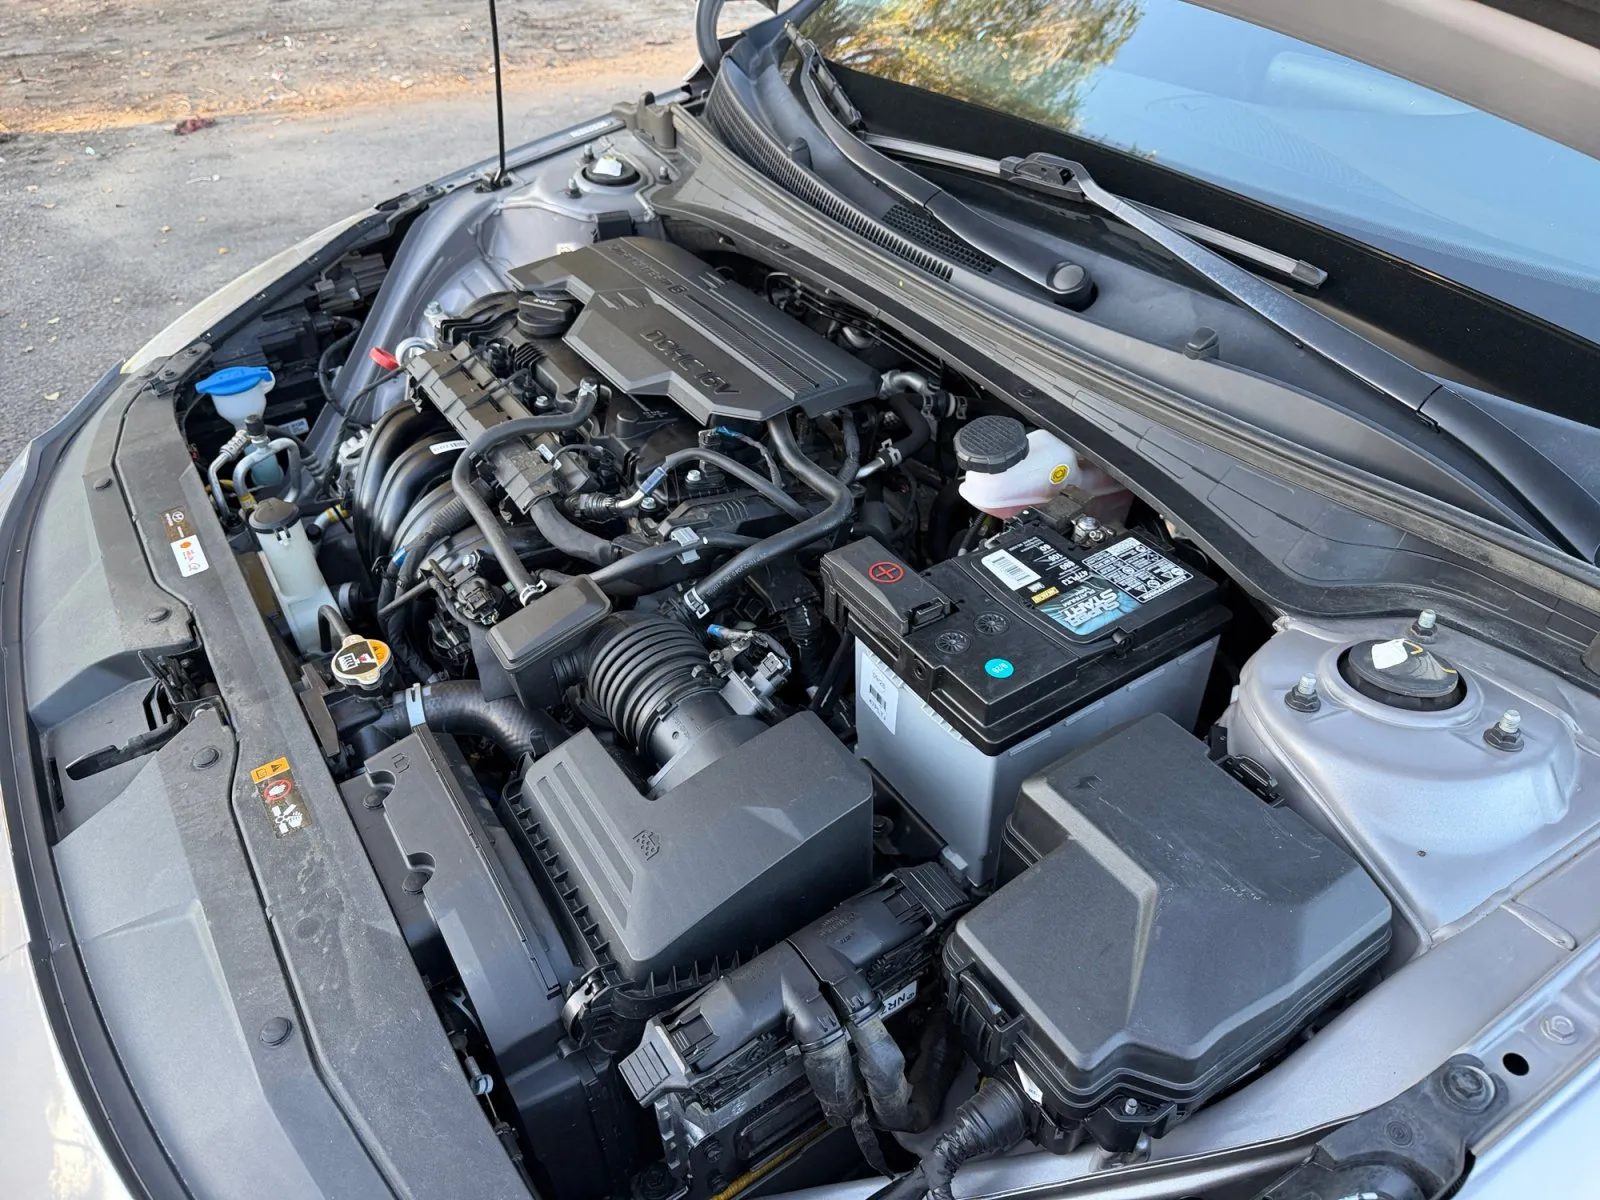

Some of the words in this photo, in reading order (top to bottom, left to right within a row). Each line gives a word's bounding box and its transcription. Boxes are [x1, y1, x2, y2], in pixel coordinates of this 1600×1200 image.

[639, 329, 705, 371] DOHC
[693, 368, 741, 395] 16V
[1062, 588, 1117, 621] START
[1069, 600, 1120, 627] SUPER
